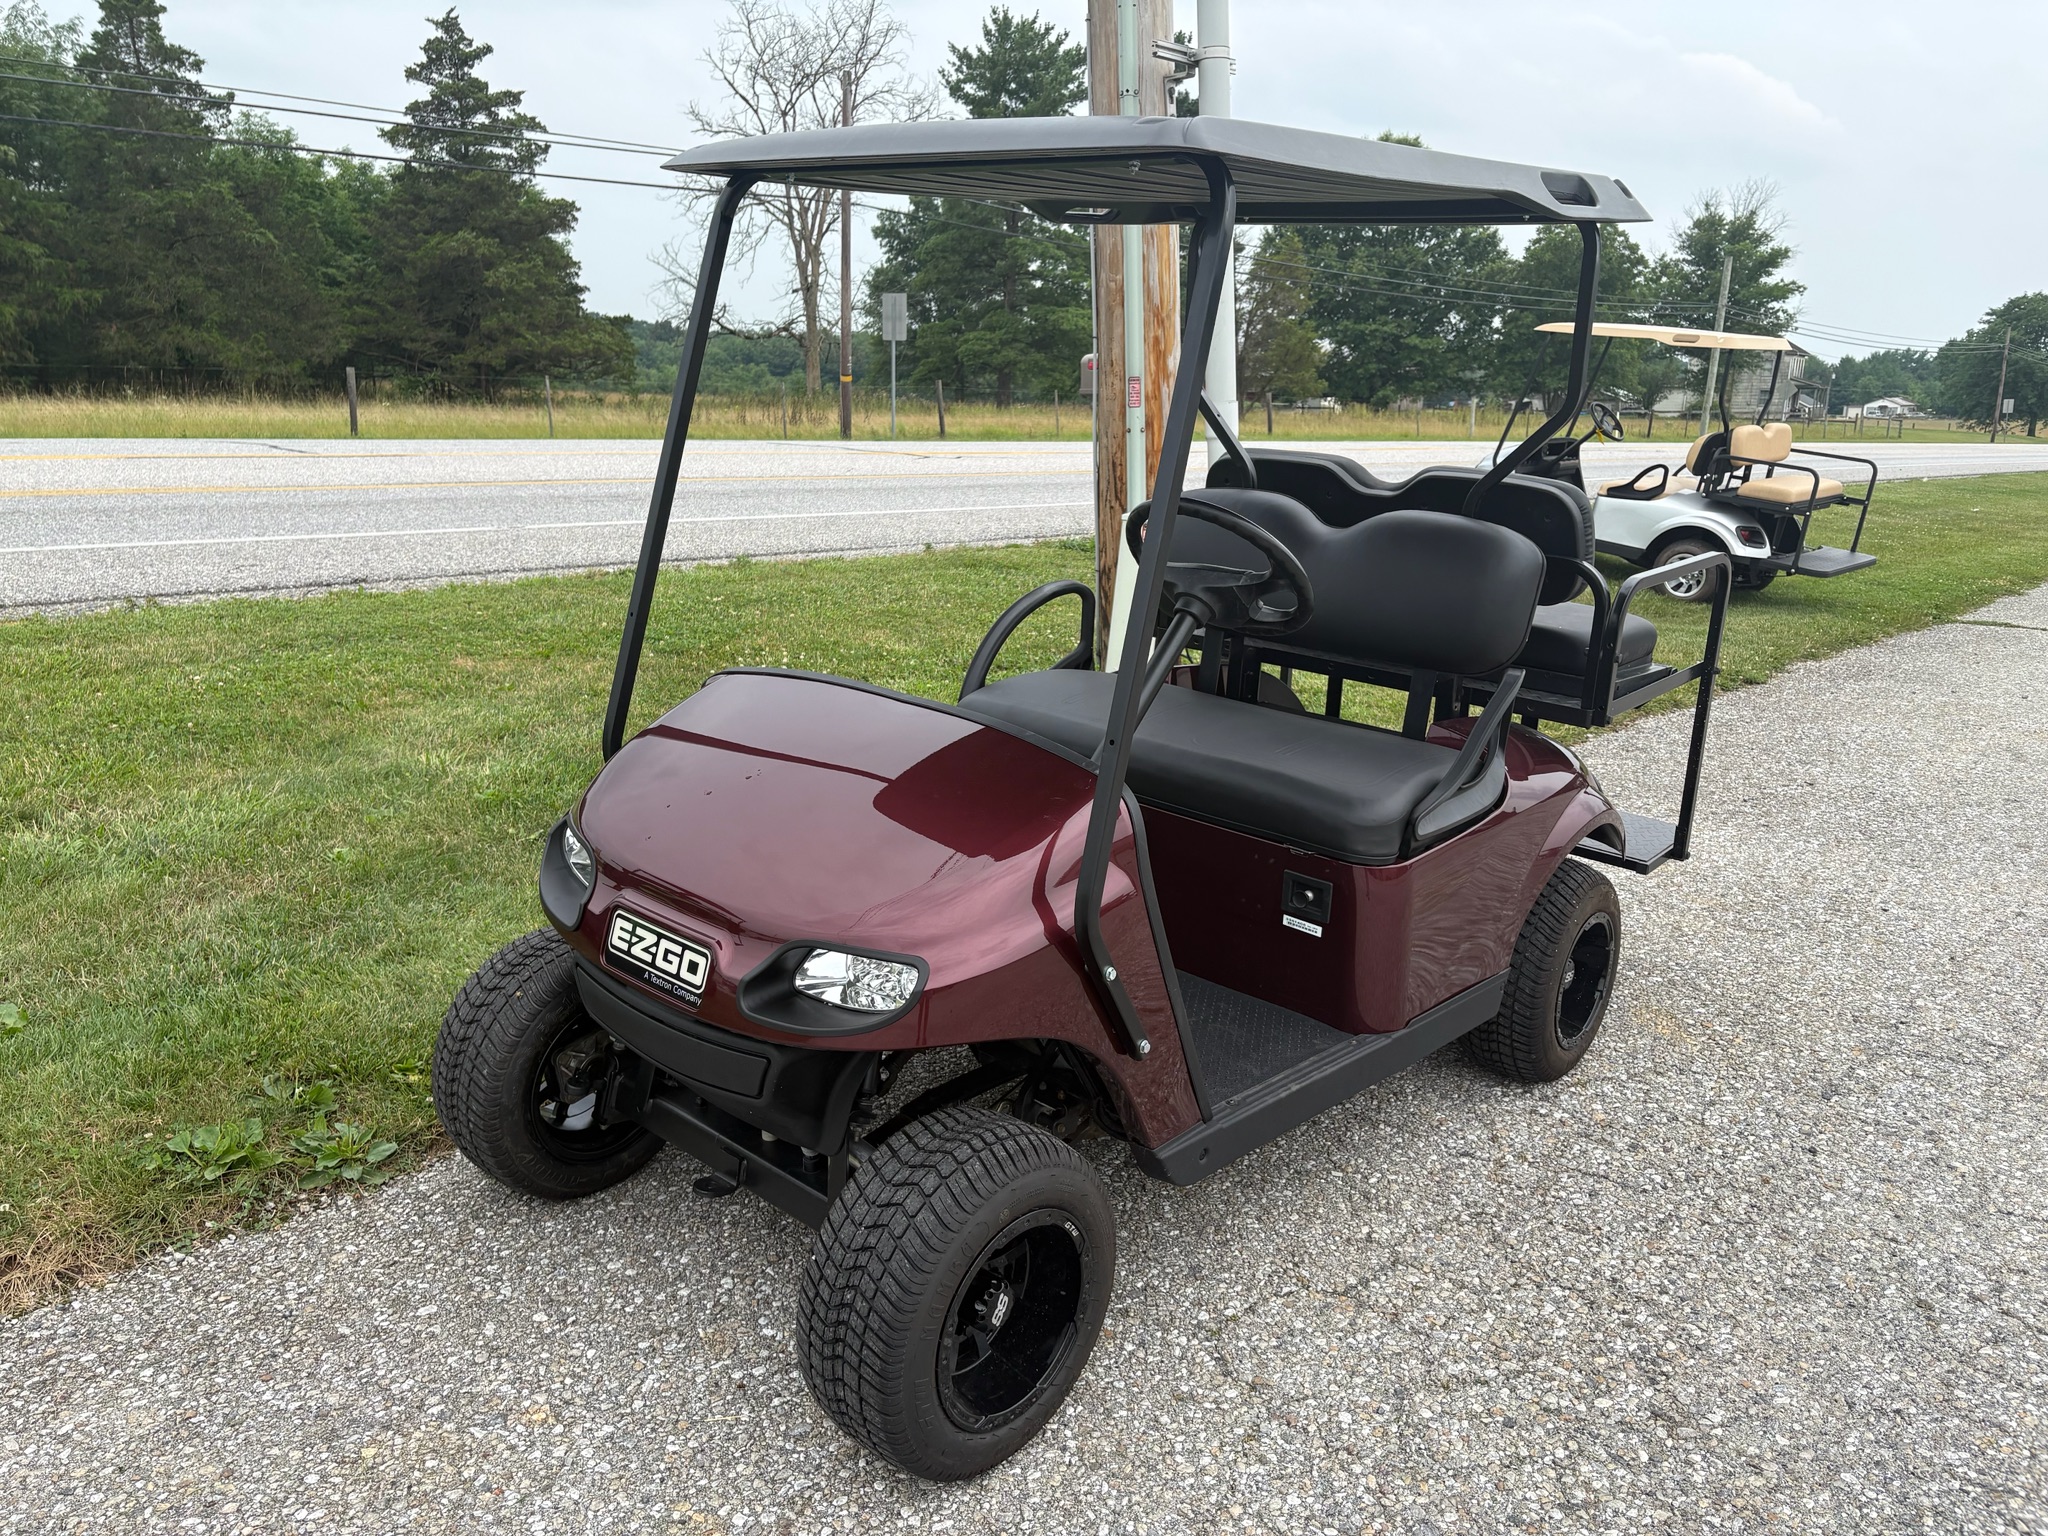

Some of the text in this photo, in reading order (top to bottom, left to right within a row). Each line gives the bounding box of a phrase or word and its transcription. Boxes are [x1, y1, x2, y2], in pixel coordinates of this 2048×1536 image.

[644, 971, 702, 1006] A Textron Company
[1064, 1221, 1080, 1237] GTW
